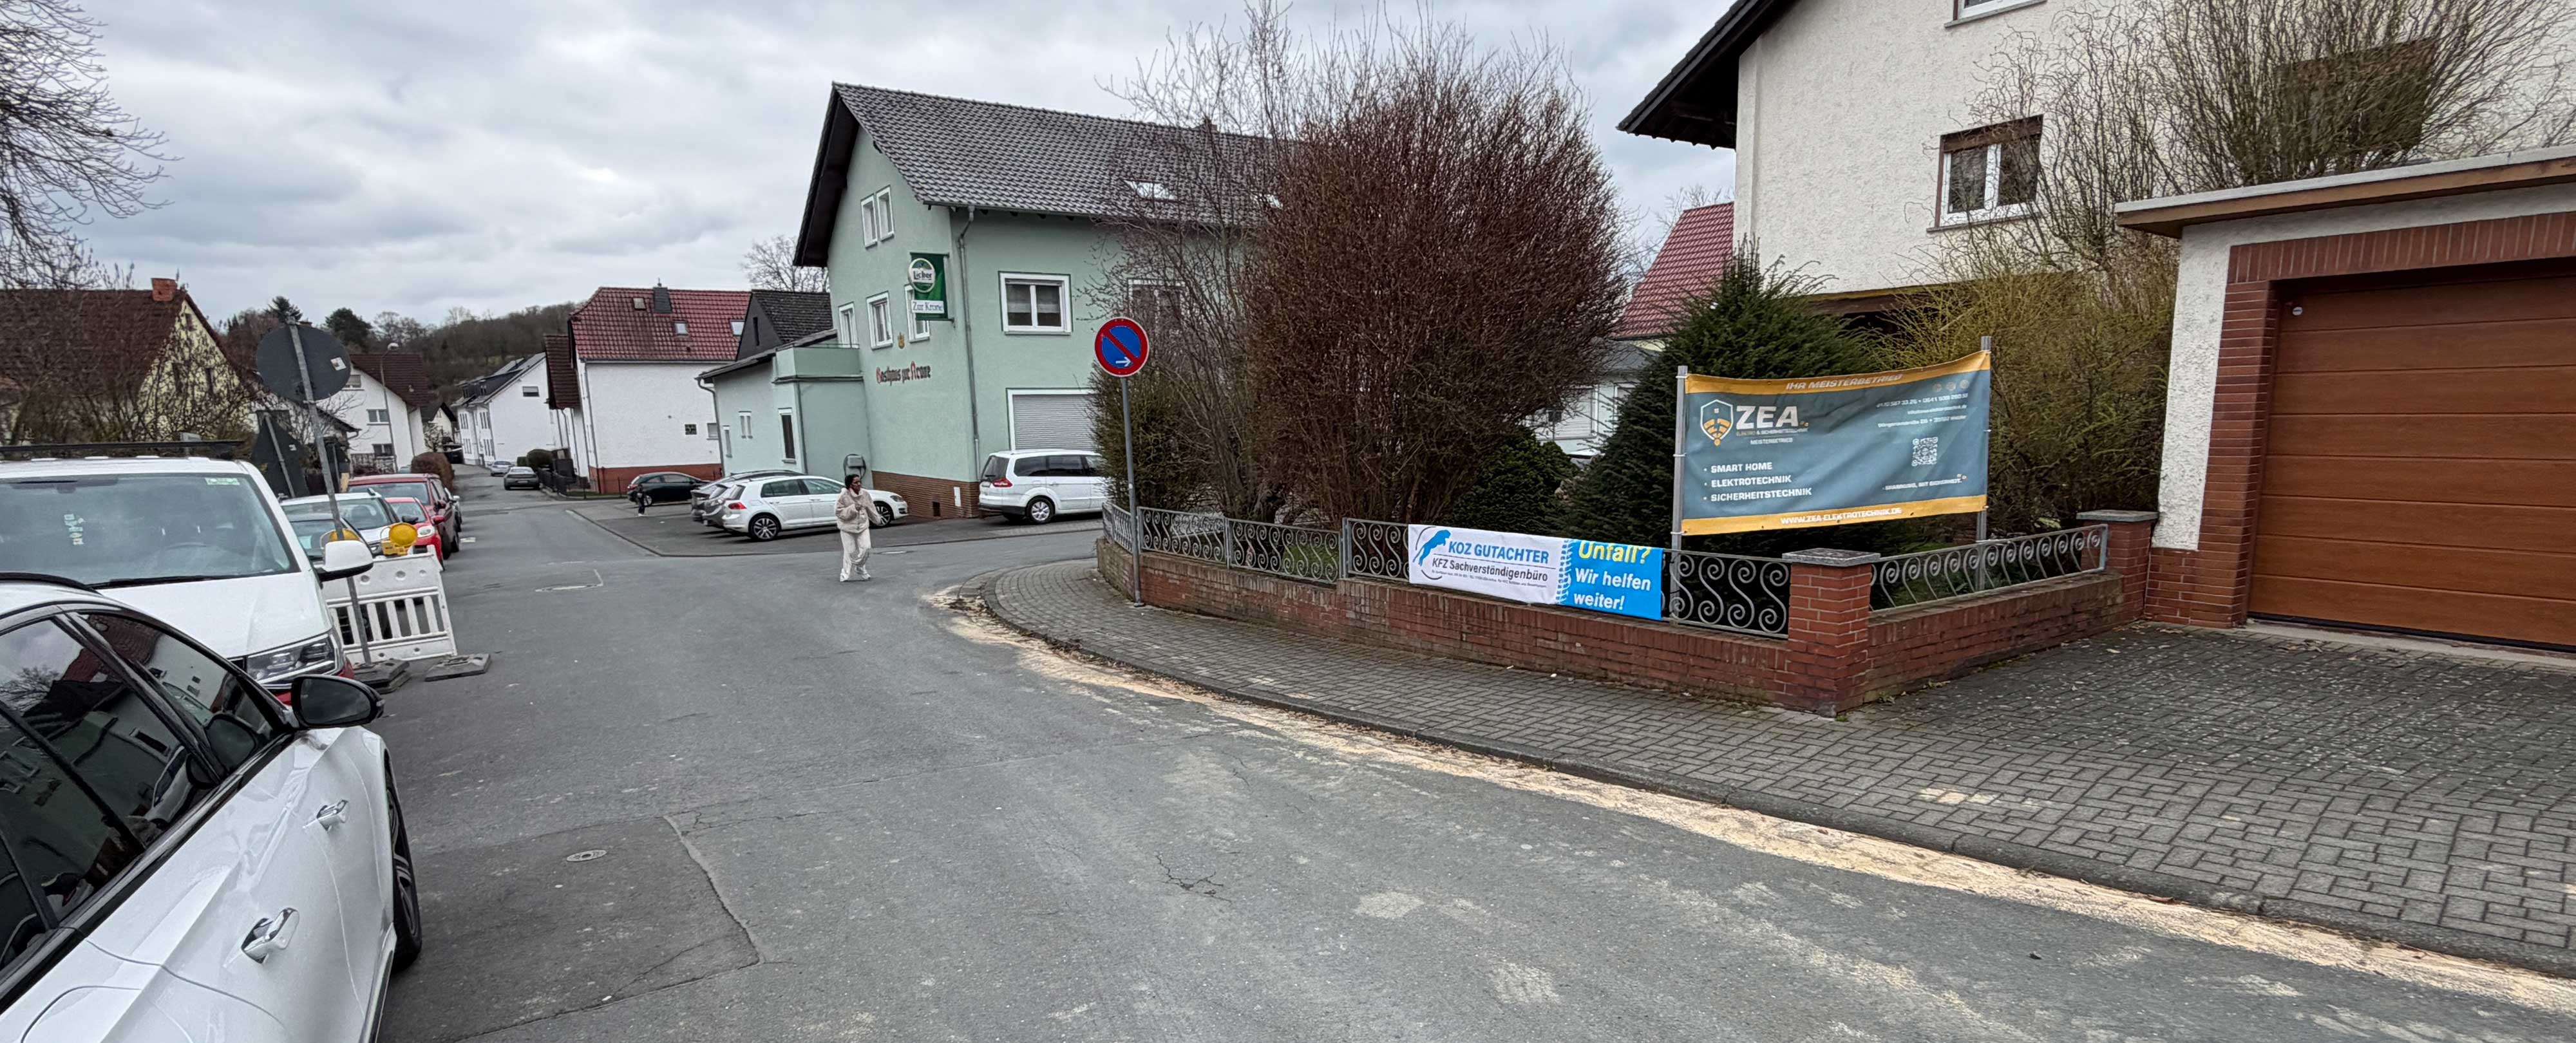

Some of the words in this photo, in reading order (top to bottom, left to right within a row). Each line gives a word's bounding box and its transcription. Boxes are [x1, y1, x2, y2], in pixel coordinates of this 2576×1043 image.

[1786, 382, 1806, 390] IHR
[1808, 373, 1903, 389] MEISTERBETRIEB
[1736, 406, 1799, 430] ZEA
[1710, 464, 1743, 473] SMART
[1745, 462, 1773, 471] HOME
[1711, 475, 1792, 488] ELEKTROTECHNIK
[1710, 487, 1812, 502] SICHERHEITSTECHNIK
[1781, 507, 1902, 524] WWW.ZEA-ELEKTROTECHNIK.DE
[1448, 541, 1472, 555] KOZ
[1474, 543, 1549, 564] GUTACHTER
[1579, 540, 1651, 564] Unfall?
[1432, 558, 1448, 568] KFZ
[1450, 559, 1548, 582] Sachverständigenbüro
[1575, 567, 1598, 585] Wir
[1602, 570, 1651, 591] helfen
[1574, 592, 1625, 610] weiter!
